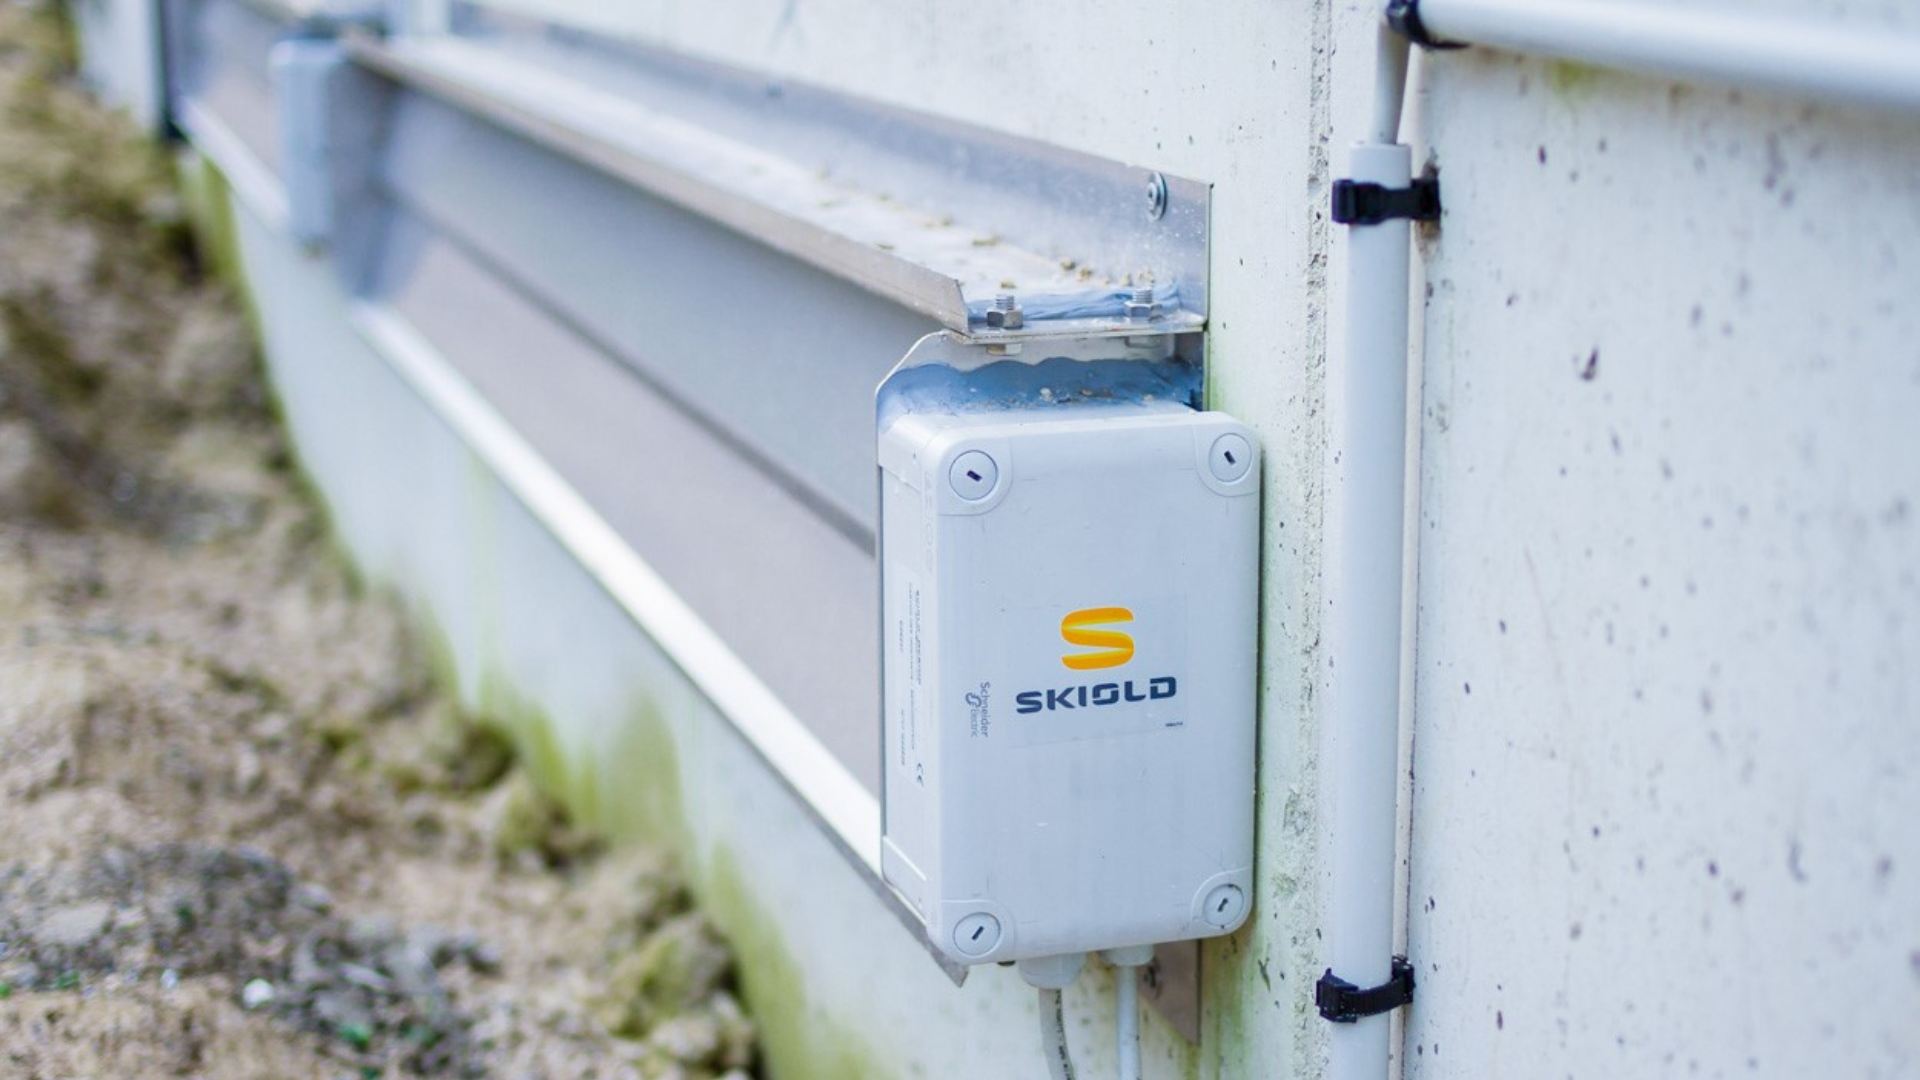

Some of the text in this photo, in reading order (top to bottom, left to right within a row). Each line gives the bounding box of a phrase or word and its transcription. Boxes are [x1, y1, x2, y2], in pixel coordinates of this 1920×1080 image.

[980, 681, 991, 738] Schneider
[1015, 675, 1178, 715] SKIOLD
[970, 709, 979, 738] Electric
